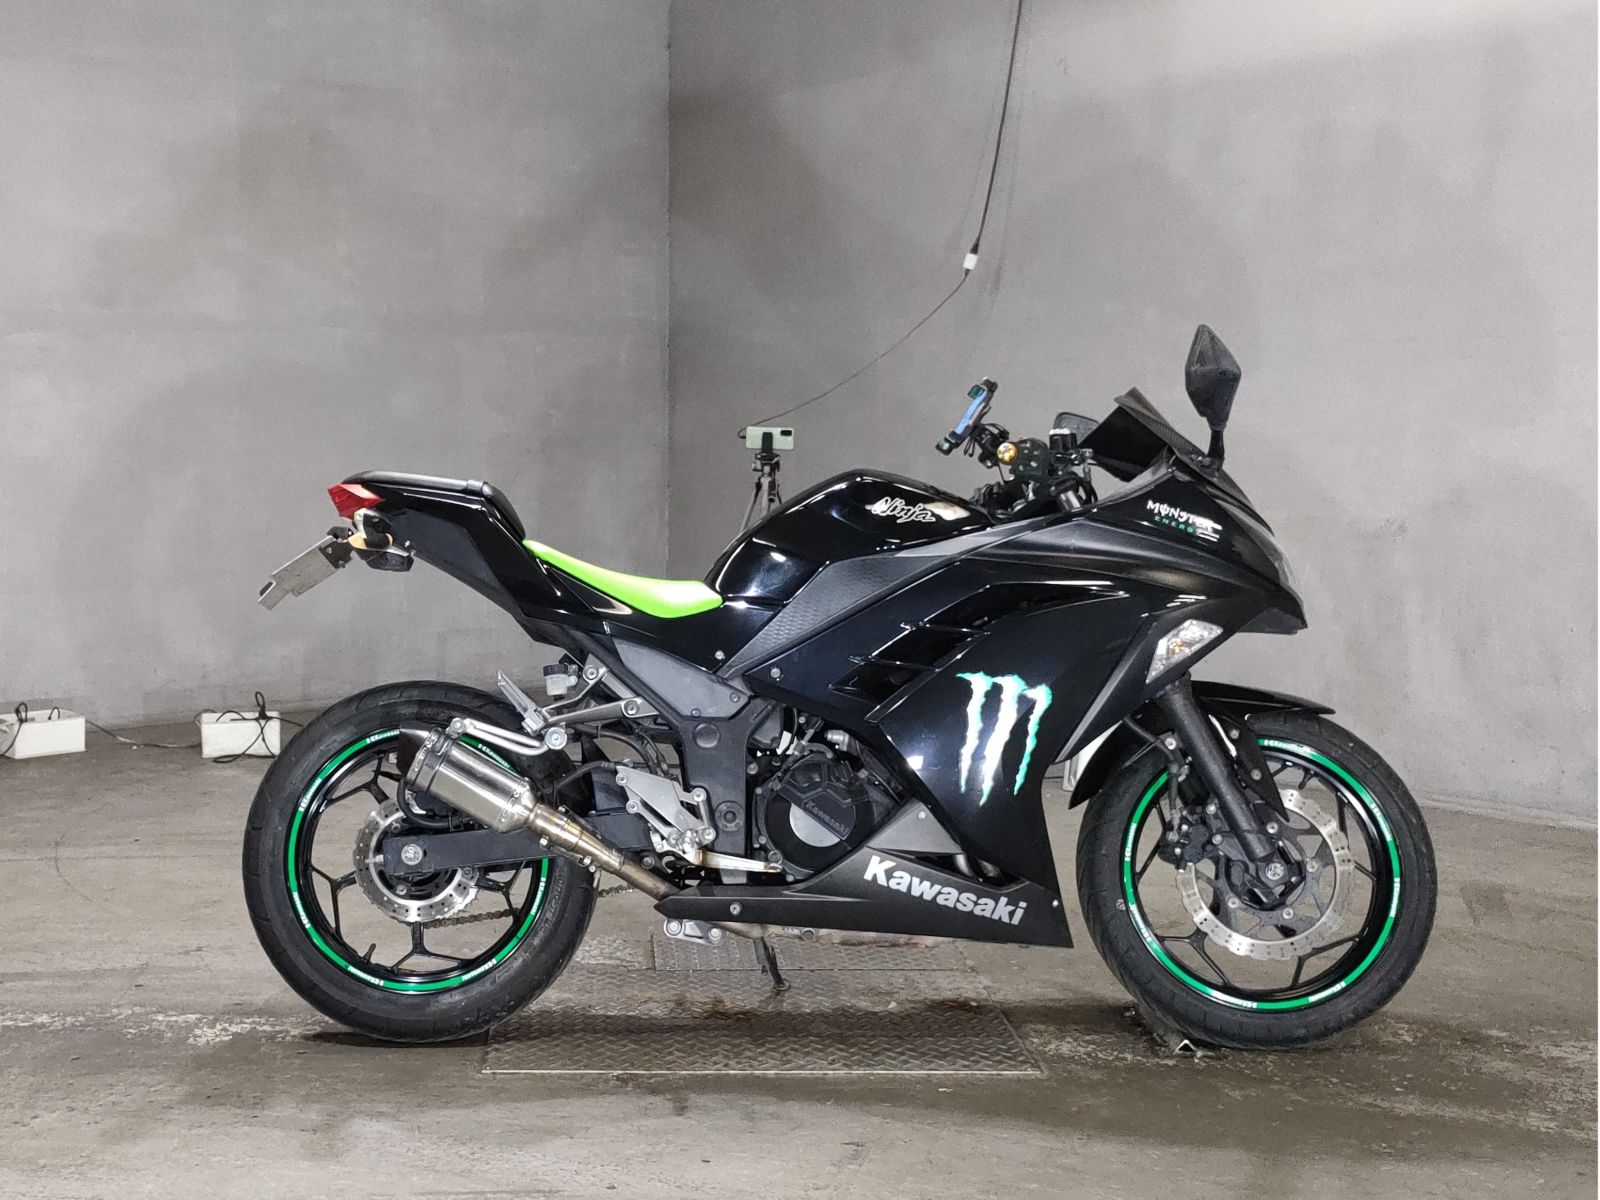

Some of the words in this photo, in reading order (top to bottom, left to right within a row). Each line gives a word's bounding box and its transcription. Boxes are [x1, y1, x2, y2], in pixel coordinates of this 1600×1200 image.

[864, 496, 936, 523] Ninja
[805, 800, 850, 836] Kawasaki
[863, 855, 1028, 925] Kawasaki
